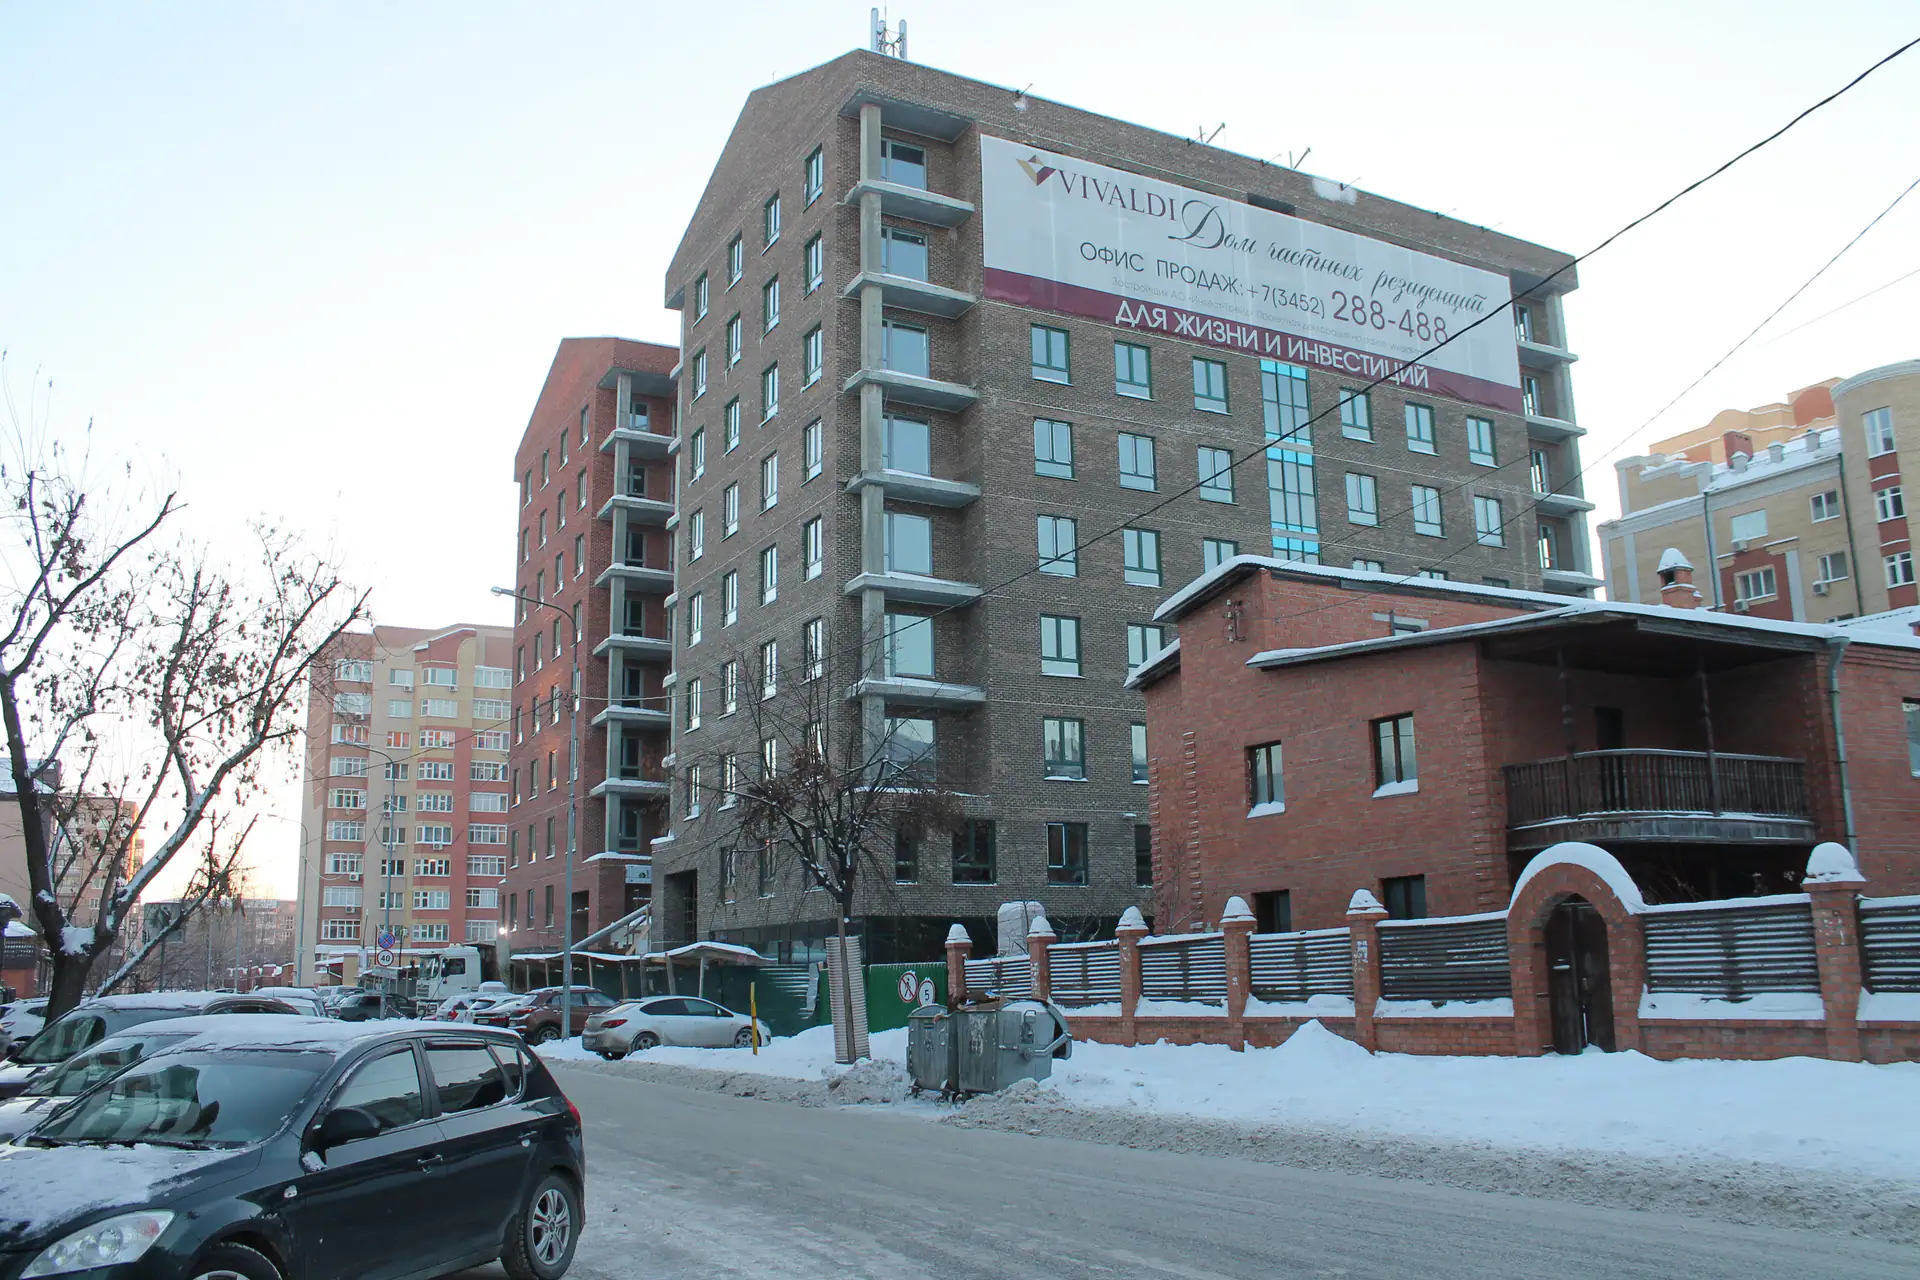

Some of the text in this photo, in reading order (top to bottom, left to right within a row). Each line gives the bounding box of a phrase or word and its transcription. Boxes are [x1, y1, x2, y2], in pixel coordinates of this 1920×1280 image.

[1058, 169, 1177, 222] VIVALDI
[1079, 241, 1145, 272] ОФИС
[1331, 289, 1448, 345] 288-488
[1168, 199, 1488, 315] Дом частных резиденций
[1115, 299, 1168, 331] ДЛЯ
[1173, 310, 1259, 351] ЖИЗНИ
[1265, 332, 1281, 356] И
[1287, 336, 1430, 389] ИНВЕСТИЦИЙ
[924, 989, 930, 1001] 5
